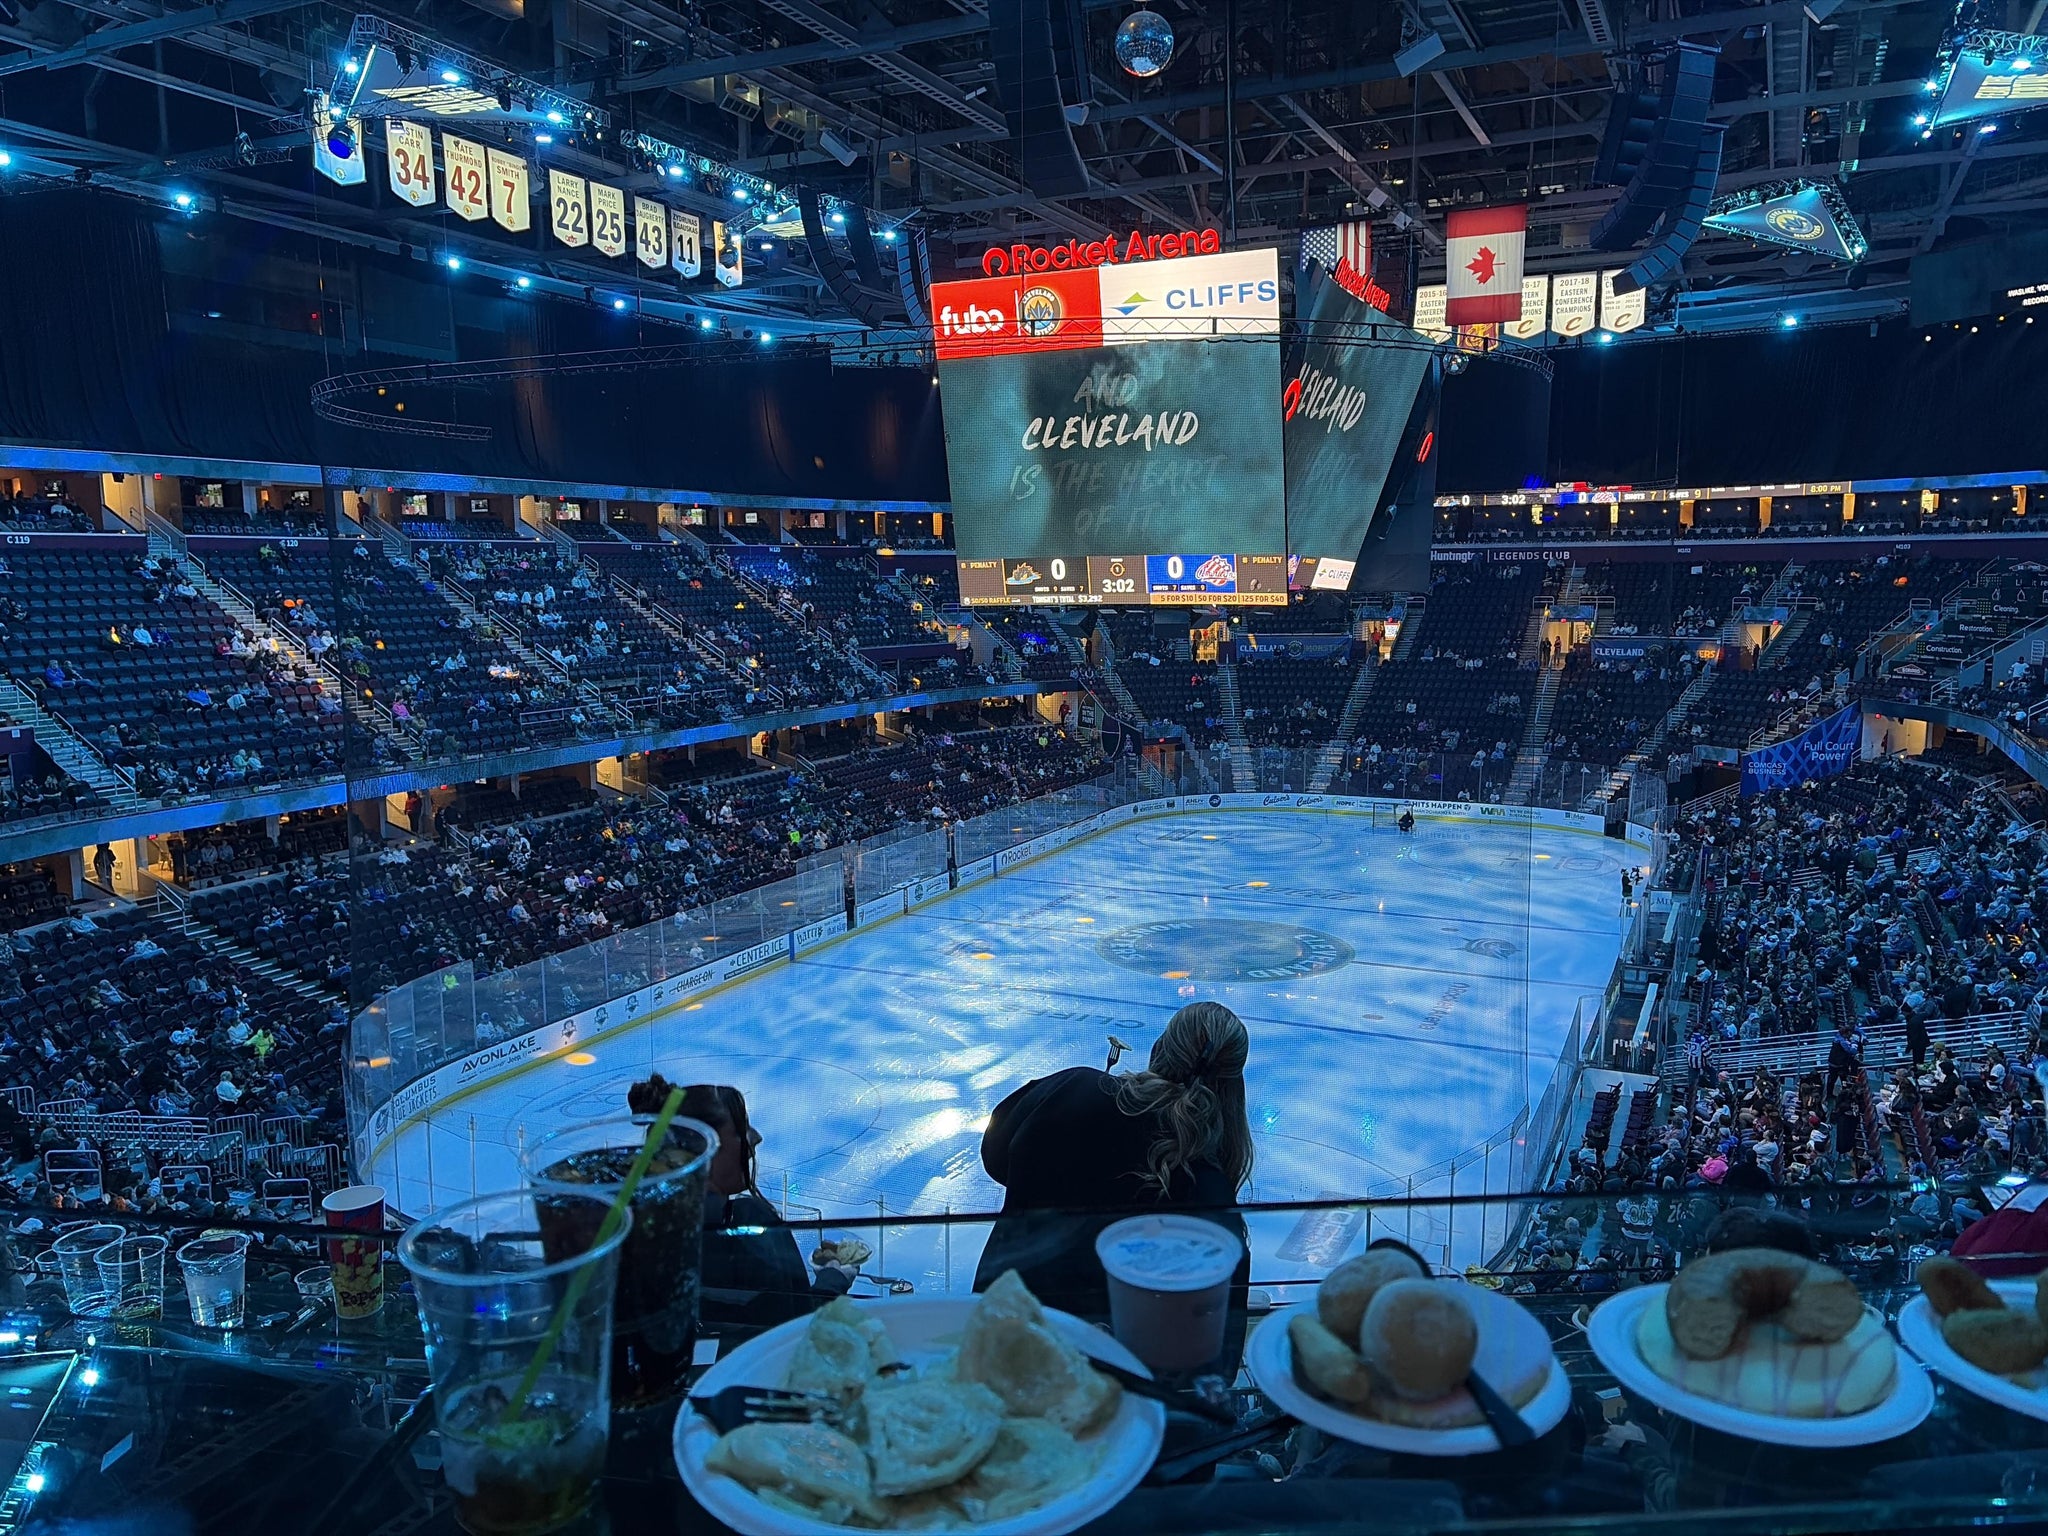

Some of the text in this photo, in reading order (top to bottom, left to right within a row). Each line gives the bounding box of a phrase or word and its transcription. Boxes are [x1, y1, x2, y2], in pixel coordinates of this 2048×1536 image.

[403, 127, 424, 140] STIN
[399, 136, 421, 150] CARR
[454, 143, 473, 156] NATE
[445, 150, 483, 168] THURMOND
[395, 148, 430, 191] 34
[496, 165, 520, 180] SMITH
[451, 165, 483, 206] 42
[557, 176, 579, 189] LARRY
[503, 179, 515, 214] 7
[557, 185, 580, 199] NANCE
[597, 188, 616, 200] MARK
[598, 197, 617, 209] PRICE
[641, 202, 658, 214] BRAD
[556, 197, 583, 234] 22
[672, 213, 698, 227] ZYDRUNAS
[596, 209, 622, 244] 25
[639, 222, 663, 255] 43
[677, 234, 695, 265] 11
[1011, 228, 1219, 274] Rocket Arena
[1338, 258, 1391, 312] Rocket Arena
[1559, 277, 1590, 287] 2017-18
[1166, 280, 1276, 310] CLIFFS
[1419, 289, 1447, 299] 2015-16
[1522, 291, 1539, 299] TERN
[1560, 288, 1588, 297] EASTERN
[1420, 300, 1446, 308] EASTERN
[1521, 299, 1544, 307] ERENCE
[1554, 296, 1593, 306] CONFERENCE
[1415, 308, 1446, 317] CONFEREN
[1556, 305, 1591, 315] CHAMPIONS
[940, 303, 1004, 336] fubo
[1416, 316, 1446, 325] CHAMPION
[1565, 316, 1583, 331] C
[1614, 313, 1632, 328] C
[1517, 319, 1534, 334] C
[1074, 372, 1138, 412] AND
[1021, 409, 1199, 452] CLEVELAND
[1009, 455, 1226, 500] IS THE HEART
[1462, 495, 1470, 505] 0
[1501, 494, 1526, 505] 3:02
[1579, 492, 1587, 503] 0
[1650, 491, 1657, 499] 7
[1694, 489, 1701, 498] 9
[1810, 485, 1828, 493] 8:00
[1075, 505, 1115, 536] OF
[7, 536, 30, 544] C 119
[286, 539, 299, 547] 120
[1252, 556, 1283, 564] PENALTY
[1493, 552, 1540, 560] LEGENDS
[1542, 552, 1570, 560] CLUB
[970, 561, 998, 569] PENALTY
[1050, 556, 1183, 580] 0 0
[1328, 569, 1350, 581] CLIFFS
[1102, 579, 1135, 593] 3:02
[1181, 595, 1194, 603] $10
[1223, 595, 1237, 603] $20
[1242, 595, 1254, 603] 125
[1255, 595, 1269, 603] FOR
[1270, 595, 1285, 603] $40
[1595, 647, 1644, 656] CLEVELAND
[1925, 645, 1963, 654] Construction.
[1804, 741, 1855, 751] Full Court
[1811, 751, 1845, 761] Power
[1748, 761, 1787, 769] COMCAST
[1748, 768, 1786, 776] BUSINESS
[1431, 802, 1462, 810] HAPPEN
[1008, 845, 1032, 863] Rocket
[736, 942, 770, 967] CENTER
[771, 938, 784, 953] ICE
[1246, 934, 1337, 979] CLEVELAND
[461, 1035, 536, 1074] AVONLAKE
[507, 1054, 521, 1064] Jeep
[408, 1086, 437, 1114] JACKETS
